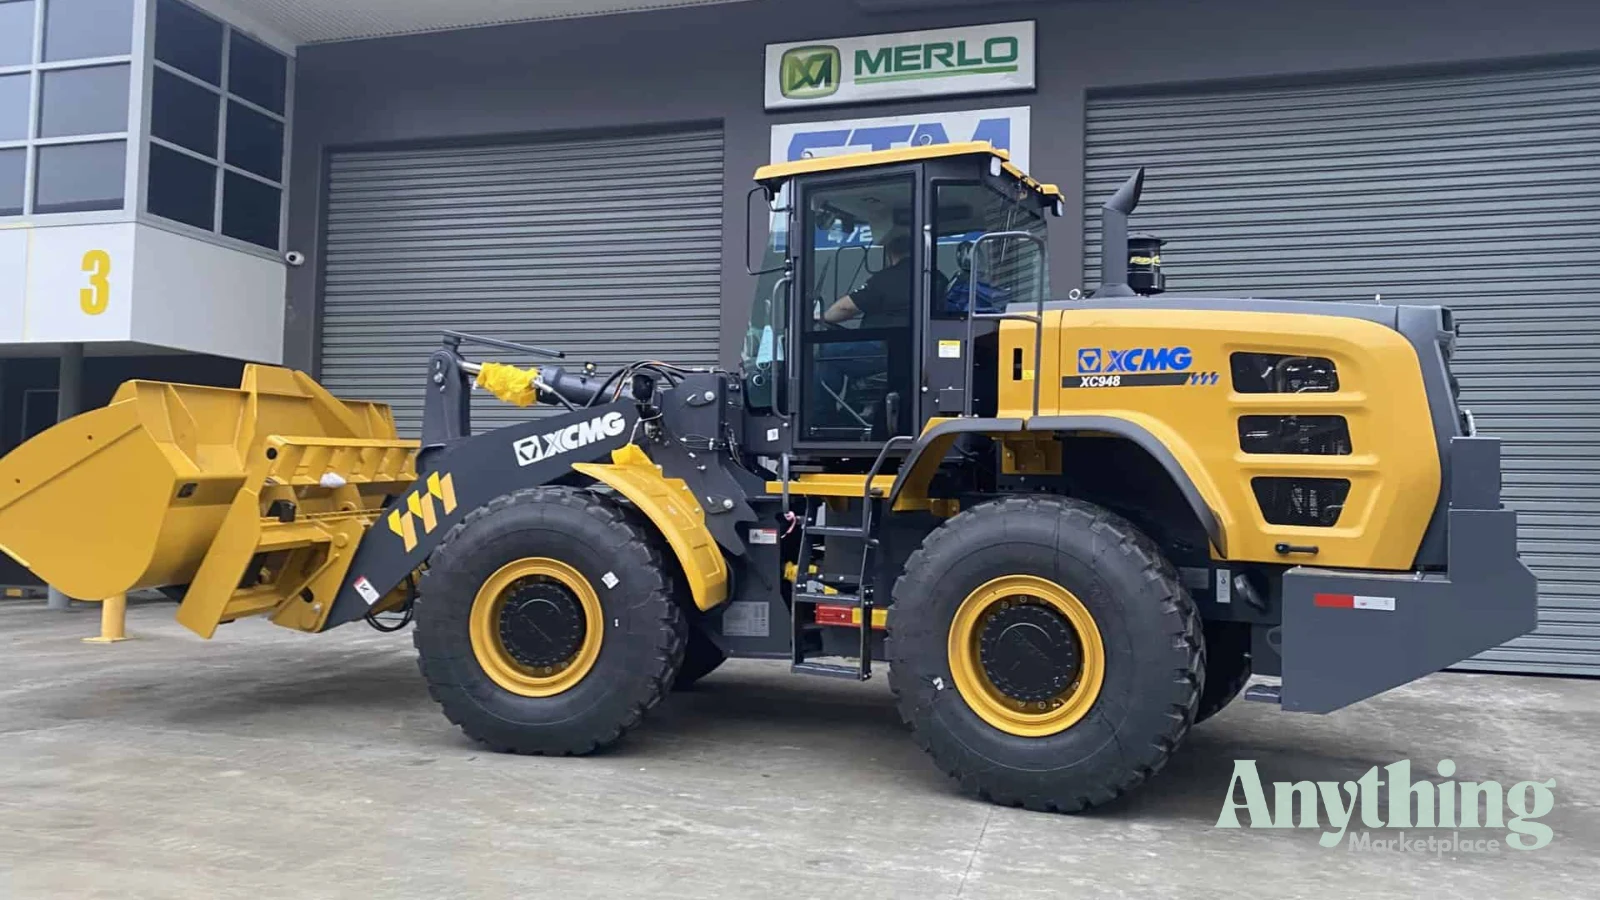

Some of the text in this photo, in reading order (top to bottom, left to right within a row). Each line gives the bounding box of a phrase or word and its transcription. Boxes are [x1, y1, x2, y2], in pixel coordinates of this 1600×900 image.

[854, 36, 1018, 76] MERLO
[80, 249, 111, 316] 3
[1103, 346, 1193, 373] XCMG
[1079, 376, 1121, 388] XC948
[541, 411, 626, 458] XCMG
